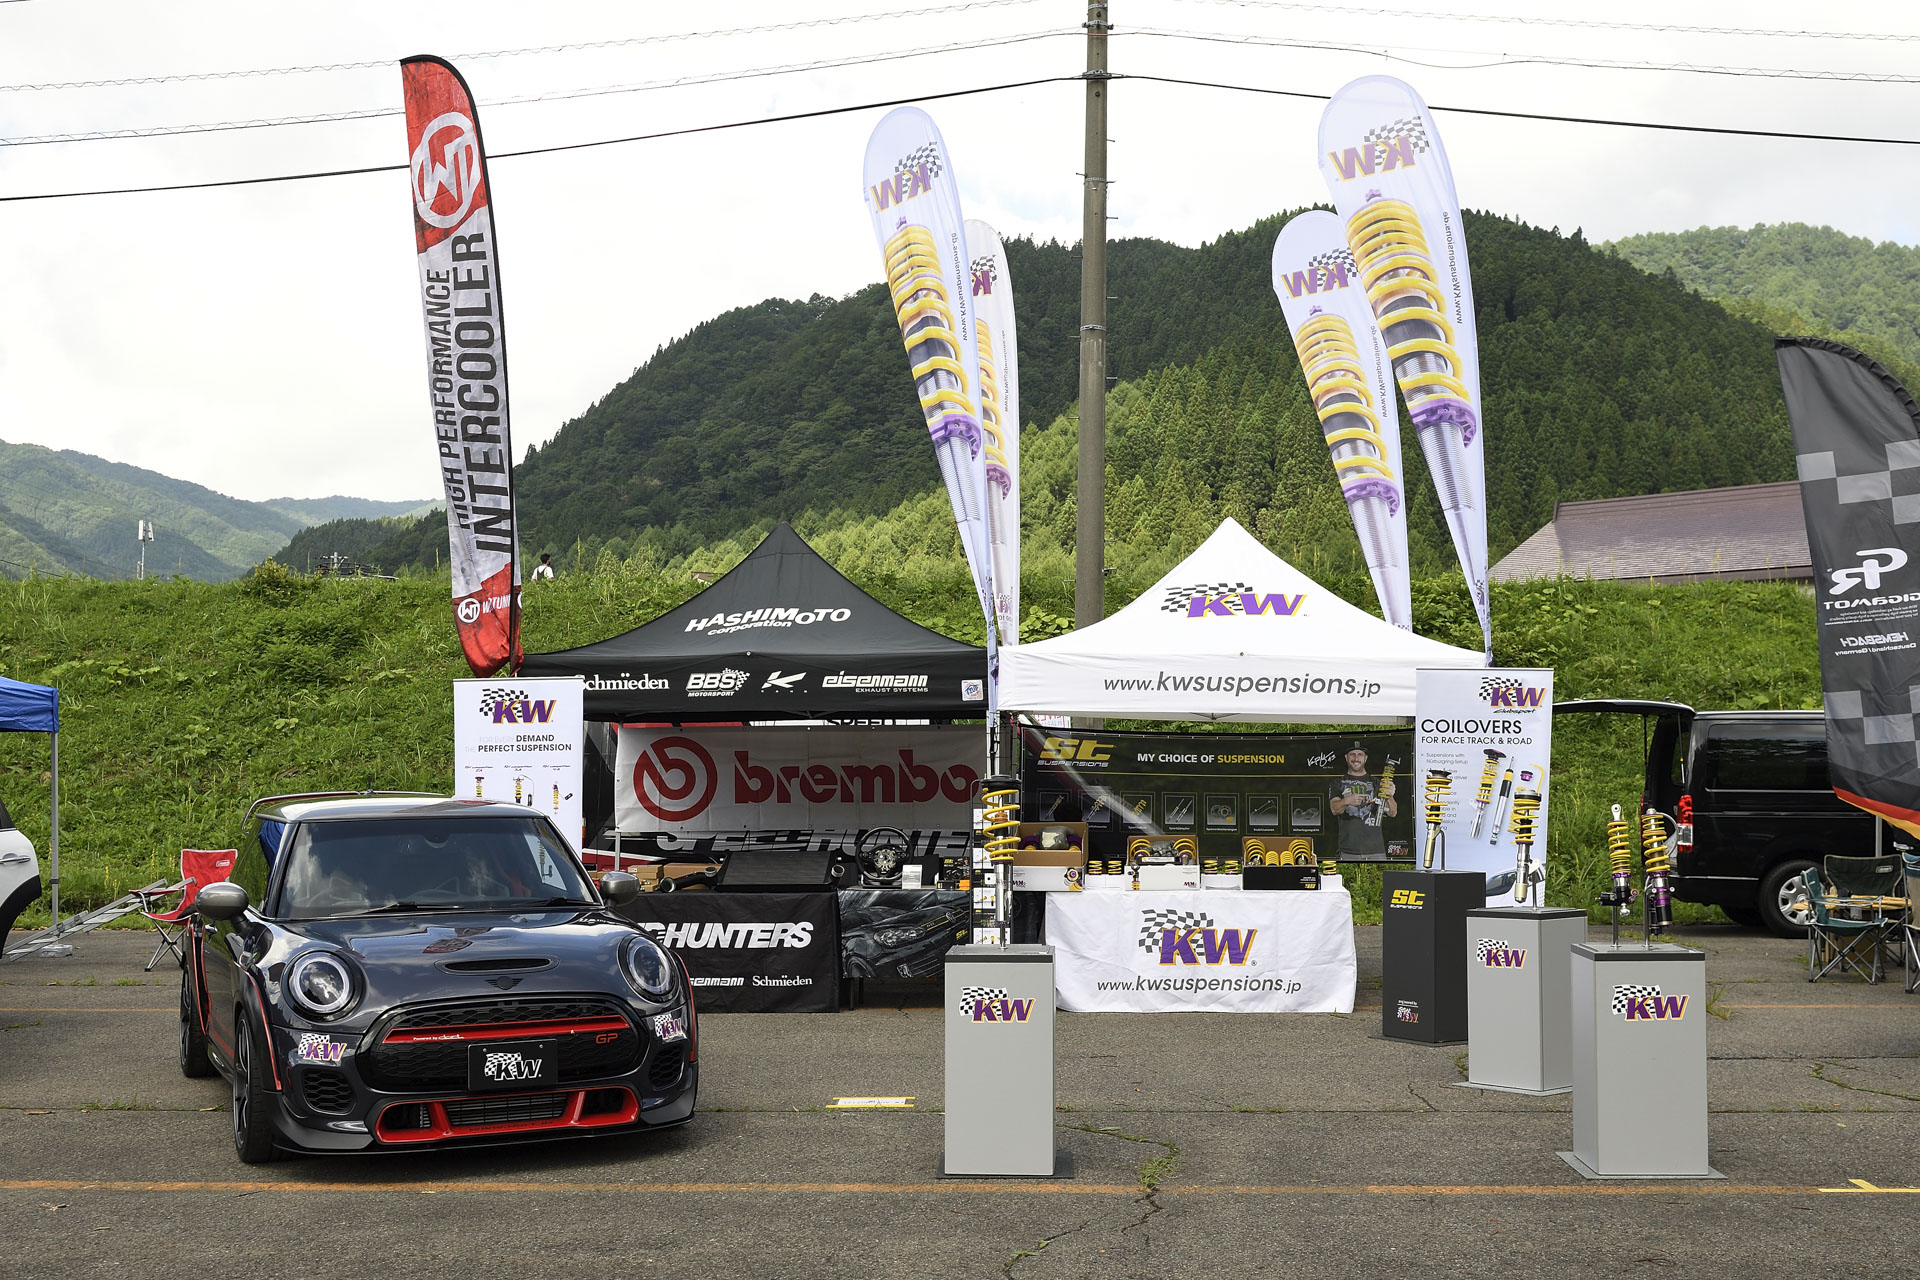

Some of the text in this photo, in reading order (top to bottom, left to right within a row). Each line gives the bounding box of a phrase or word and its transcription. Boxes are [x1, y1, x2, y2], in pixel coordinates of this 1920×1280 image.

[426, 268, 460, 459] PERFORMANCE
[451, 232, 513, 554] INTERCOOLER
[1186, 592, 1308, 618] KW
[707, 619, 793, 636] corporation
[578, 672, 670, 691] chmïeden
[686, 672, 738, 692] BBS
[822, 671, 928, 688] eisenmann
[1103, 671, 1381, 698] www.kwsuspensions.jp
[1490, 687, 1547, 708] KW
[493, 699, 557, 725] KW
[1421, 719, 1522, 734] COILOVERS
[478, 744, 515, 753] PERFECT
[516, 743, 572, 752] SUSPENSION
[516, 734, 555, 743] DEMAND
[1421, 736, 1439, 744] FOR
[1467, 737, 1496, 745] TRACK
[1497, 737, 1505, 745] &
[1137, 753, 1285, 764] MY CHOICE OF SUSPENSION
[734, 749, 981, 803] brembo
[1158, 928, 1258, 966] KW
[1485, 948, 1528, 969] KW
[752, 975, 813, 987] Schmïeden
[1096, 975, 1302, 994] www.kwsuspensions.jp
[972, 998, 1036, 1023] KW
[1625, 993, 1689, 1021] KW
[595, 1033, 618, 1045] GP
[661, 1018, 683, 1040] KW
[303, 1041, 347, 1062] KW
[494, 1059, 543, 1081] KW
